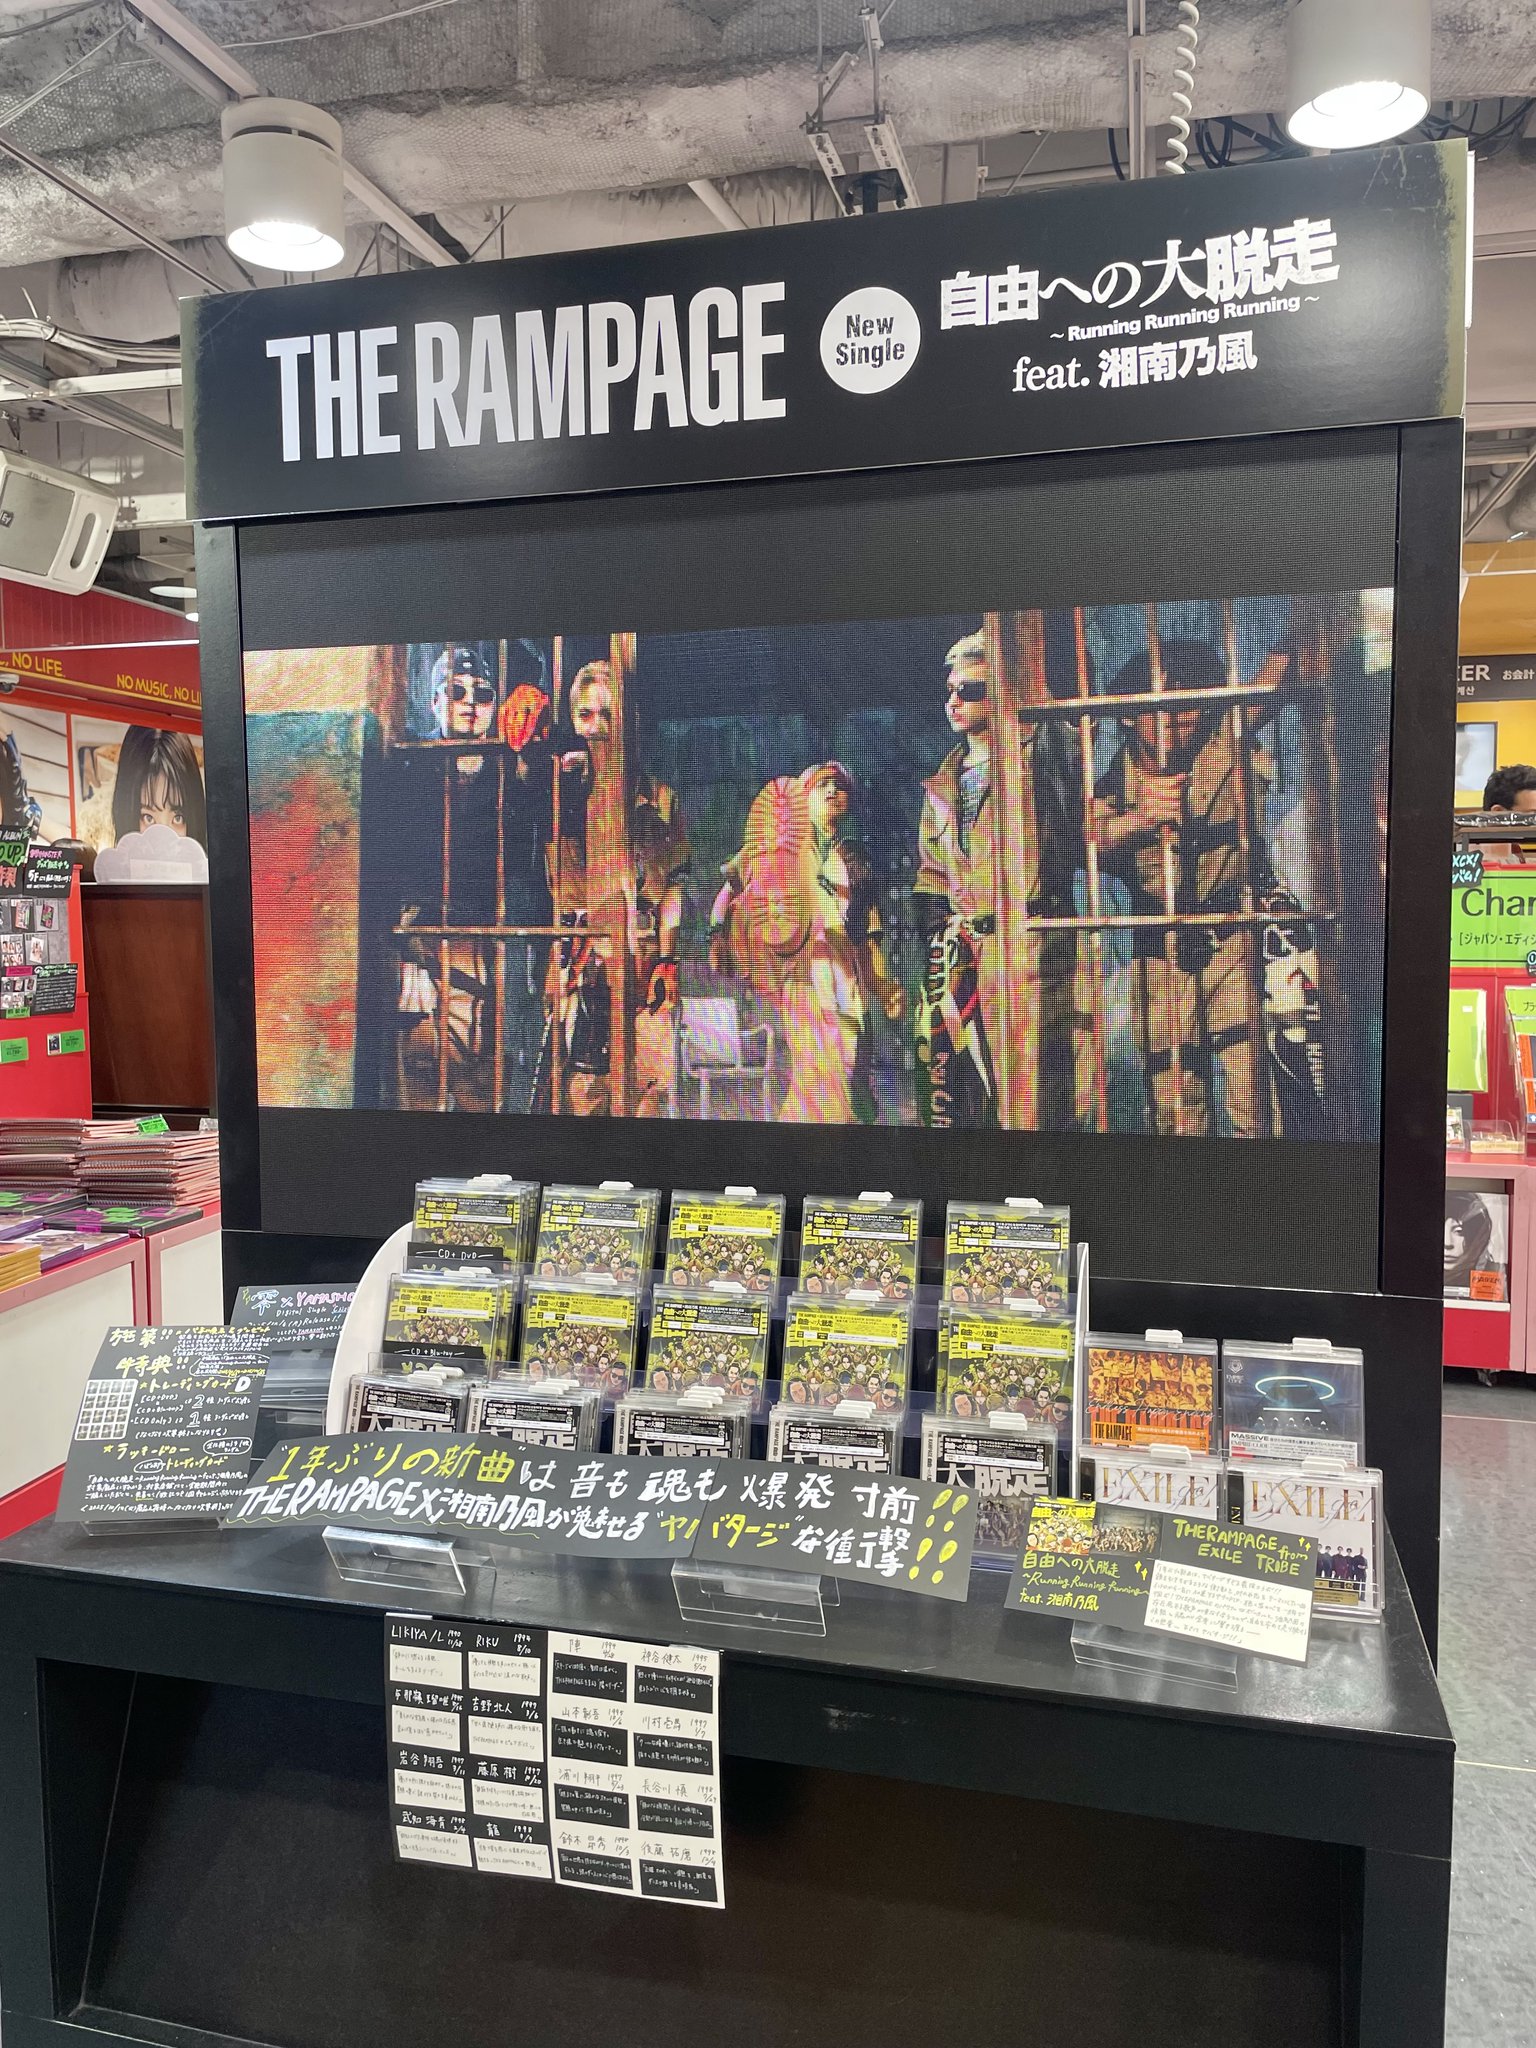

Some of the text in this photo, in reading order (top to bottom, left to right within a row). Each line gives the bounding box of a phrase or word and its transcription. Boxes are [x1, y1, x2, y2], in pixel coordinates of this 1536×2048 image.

[940, 217, 1341, 330] 自由への大脱走
[846, 314, 894, 338] New
[1144, 307, 1220, 332] Running
[835, 340, 906, 369] Single
[1012, 330, 1258, 392] feat. 湘南乃風
[266, 282, 786, 462] THE RAMPAGE
[12, 652, 32, 669] NO
[1457, 664, 1535, 681] ER お会計
[116, 674, 134, 690] NO
[174, 687, 189, 700] NO
[1102, 1466, 1211, 1508] EXILE
[1251, 1480, 1366, 1522] EXILE
[1198, 1543, 1300, 1576] EXILE TRIBE
[1277, 1545, 1309, 1560] from
[476, 1634, 500, 1648] RIKU
